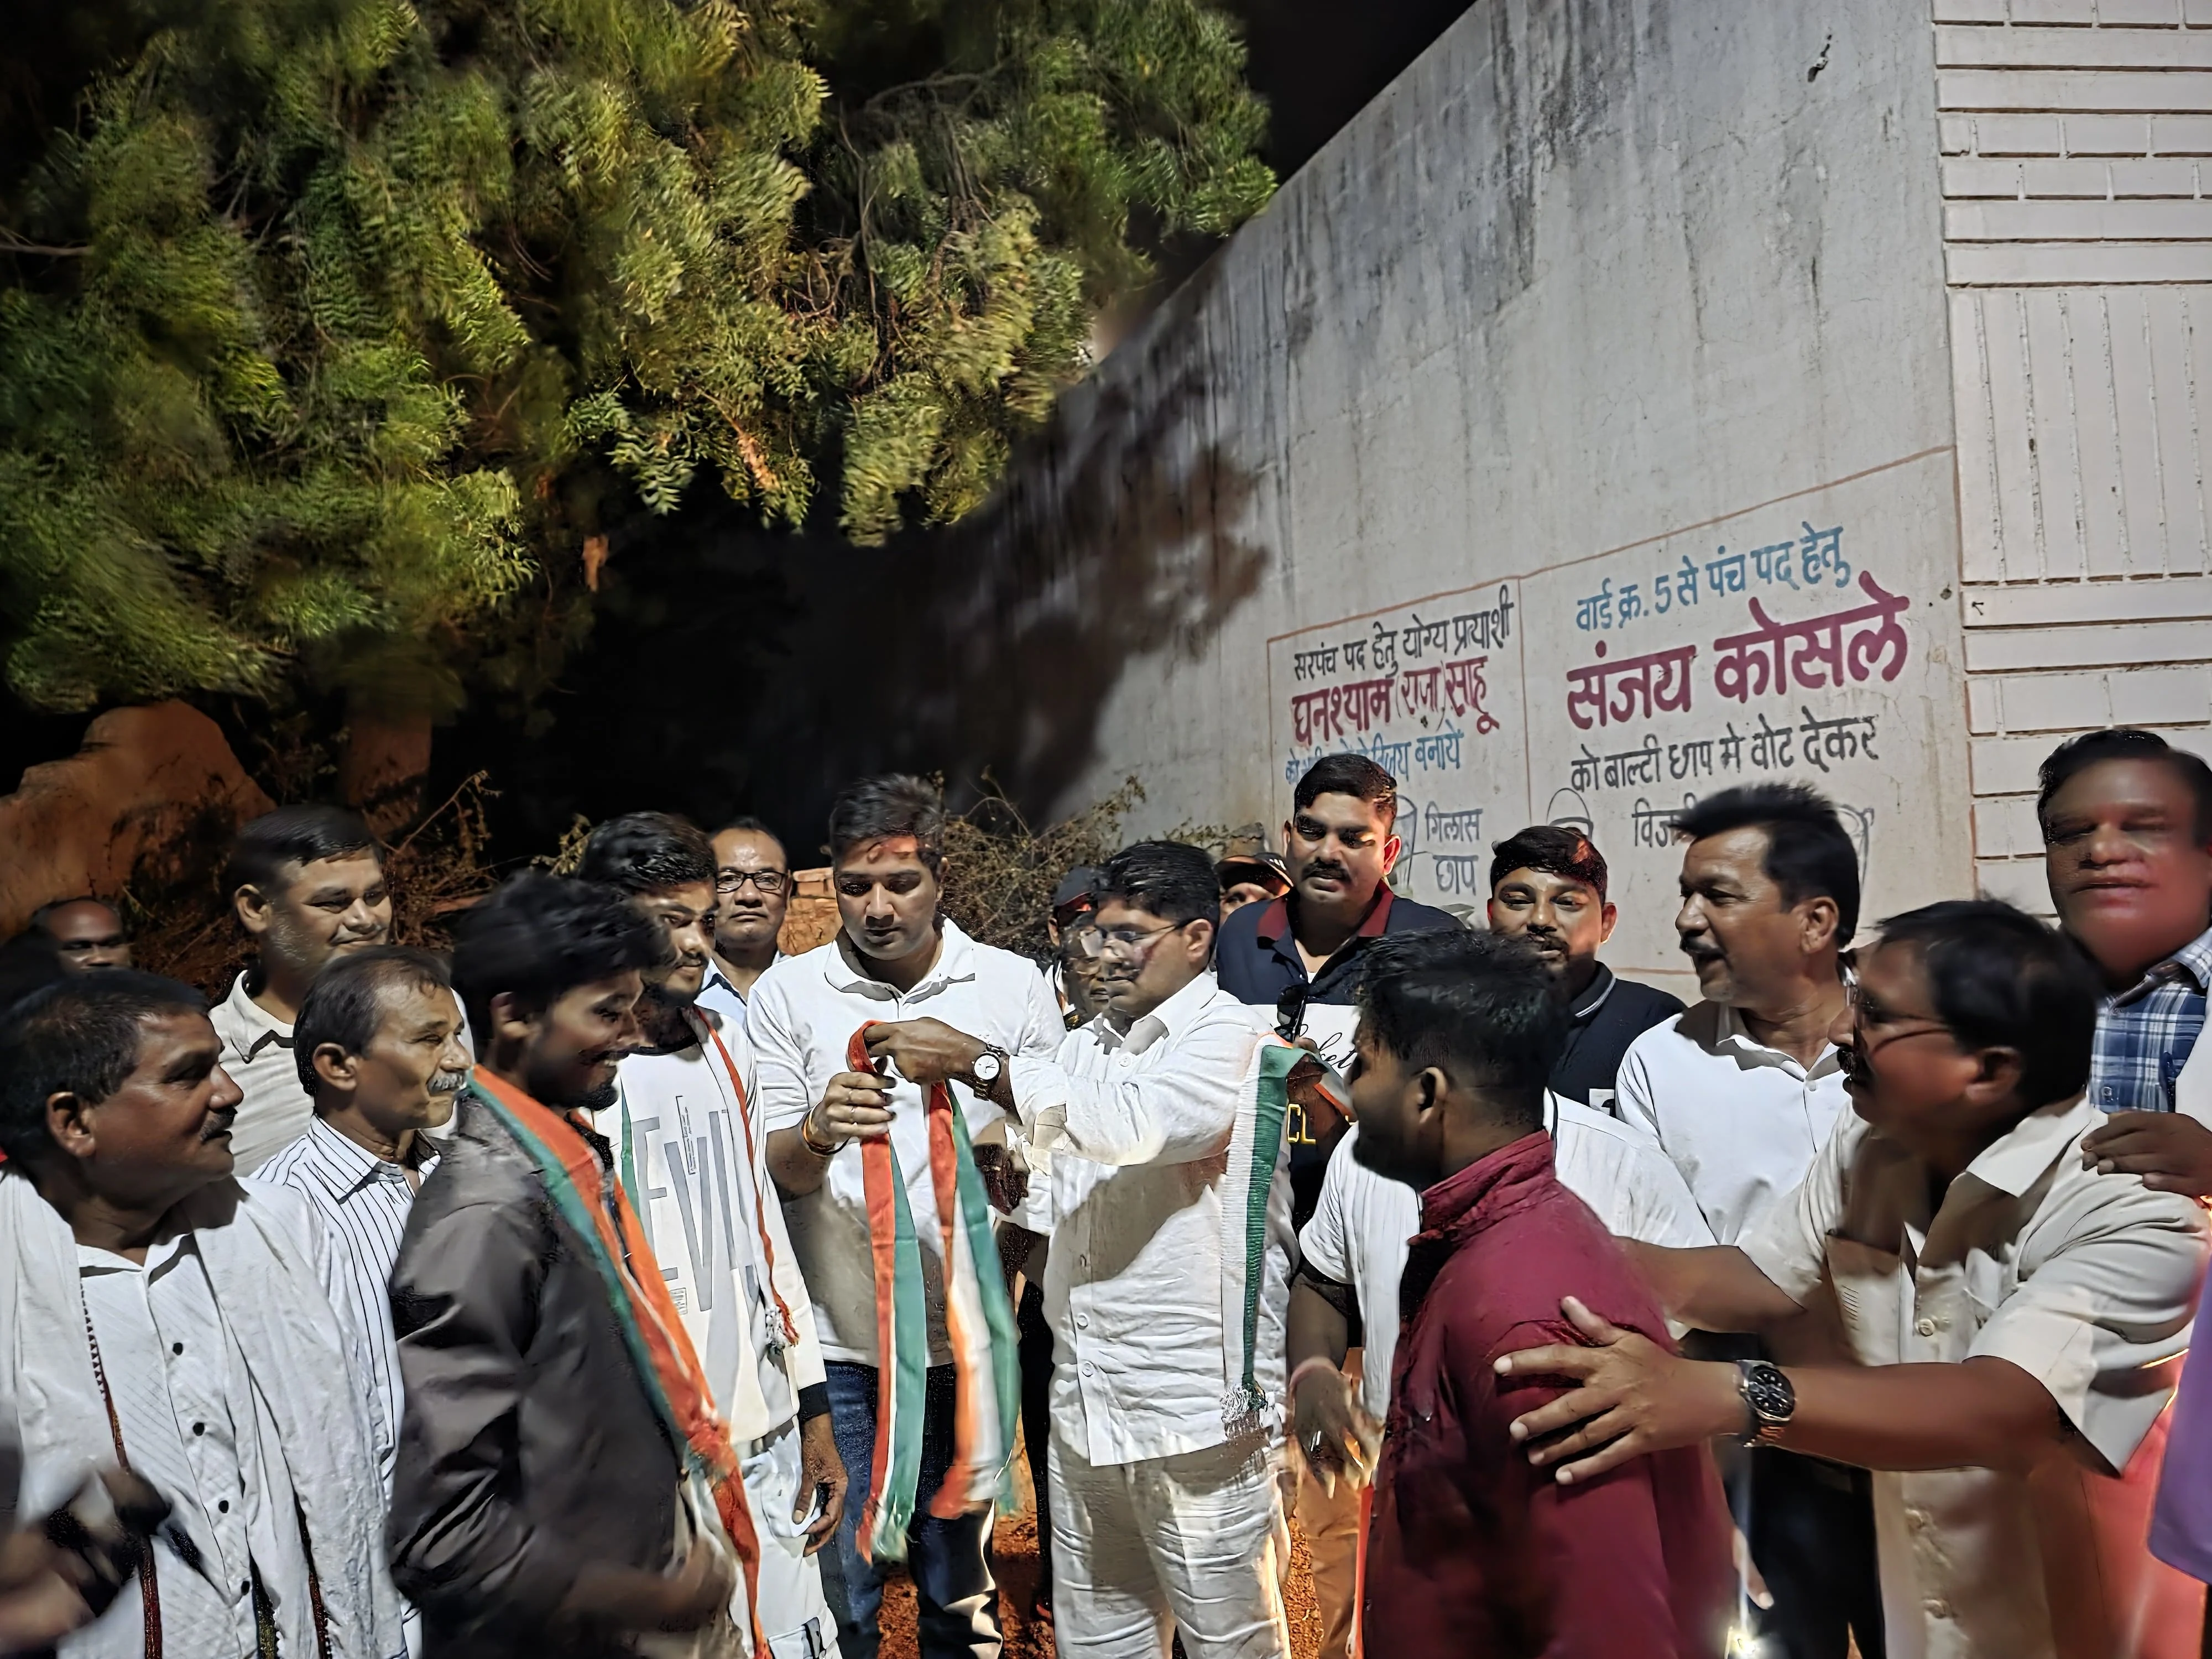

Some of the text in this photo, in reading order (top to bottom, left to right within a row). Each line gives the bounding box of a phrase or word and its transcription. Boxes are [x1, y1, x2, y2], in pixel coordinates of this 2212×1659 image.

[1576, 577, 1612, 631] वार्ड
[1655, 575, 1672, 614] 5
[1677, 555, 1699, 606] से
[1705, 545, 1746, 597] पंच
[1750, 541, 1801, 590] पद
[1799, 521, 1851, 588] हेतु
[1295, 642, 1338, 680] सरपंच
[1344, 640, 1366, 671] पद
[1372, 622, 1399, 677] हेतु
[1403, 614, 1449, 658] योग्य
[1567, 570, 1911, 730] संजय कोसले
[1292, 677, 1394, 746] घनश्याम
[1446, 655, 1499, 734] साहू
[1571, 744, 1600, 792] को
[1604, 733, 1662, 790] बाल्टी
[1668, 740, 1714, 780] छाप
[1751, 713, 1794, 769] वोट
[1800, 706, 1879, 773] देकर
[1425, 801, 1483, 842] गिलास
[1432, 854, 1479, 896] छाप
